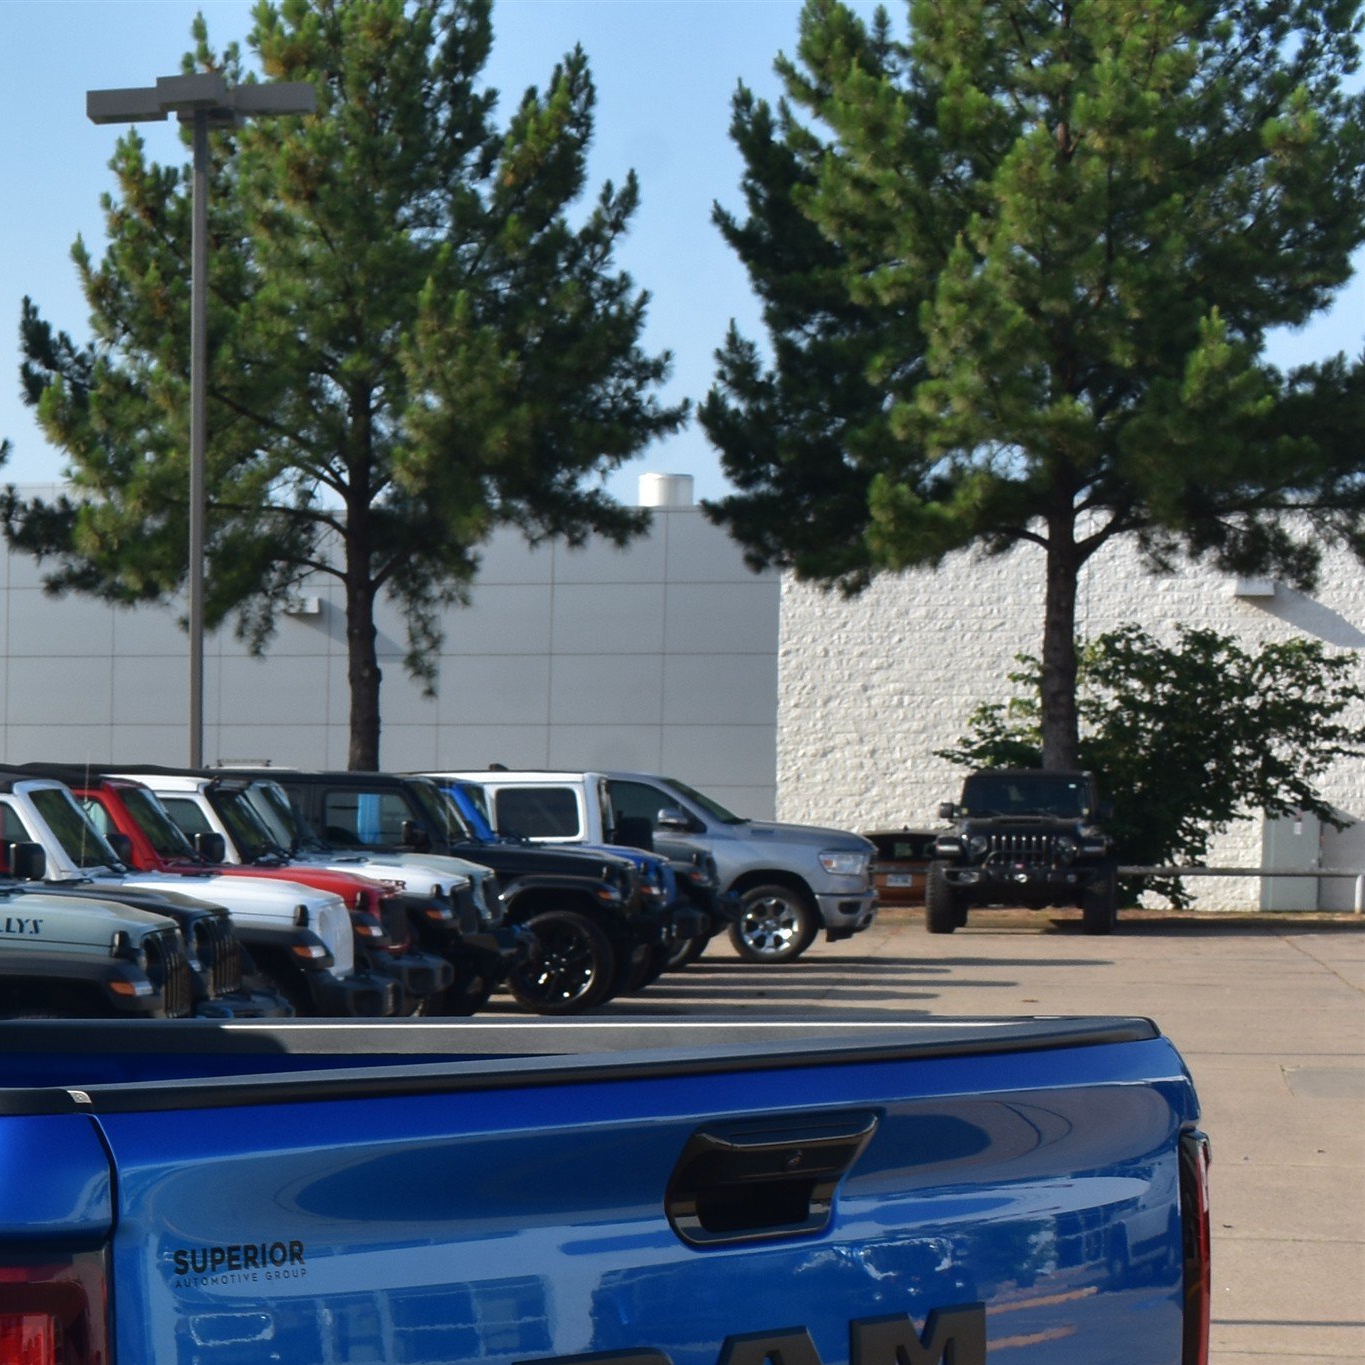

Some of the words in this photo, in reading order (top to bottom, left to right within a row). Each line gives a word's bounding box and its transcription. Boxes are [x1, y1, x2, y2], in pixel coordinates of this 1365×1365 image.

[173, 1240, 306, 1276] SUPERIOR
[175, 1272, 259, 1289] AUTOMOTIVE
[265, 1268, 308, 1281] GROUP
